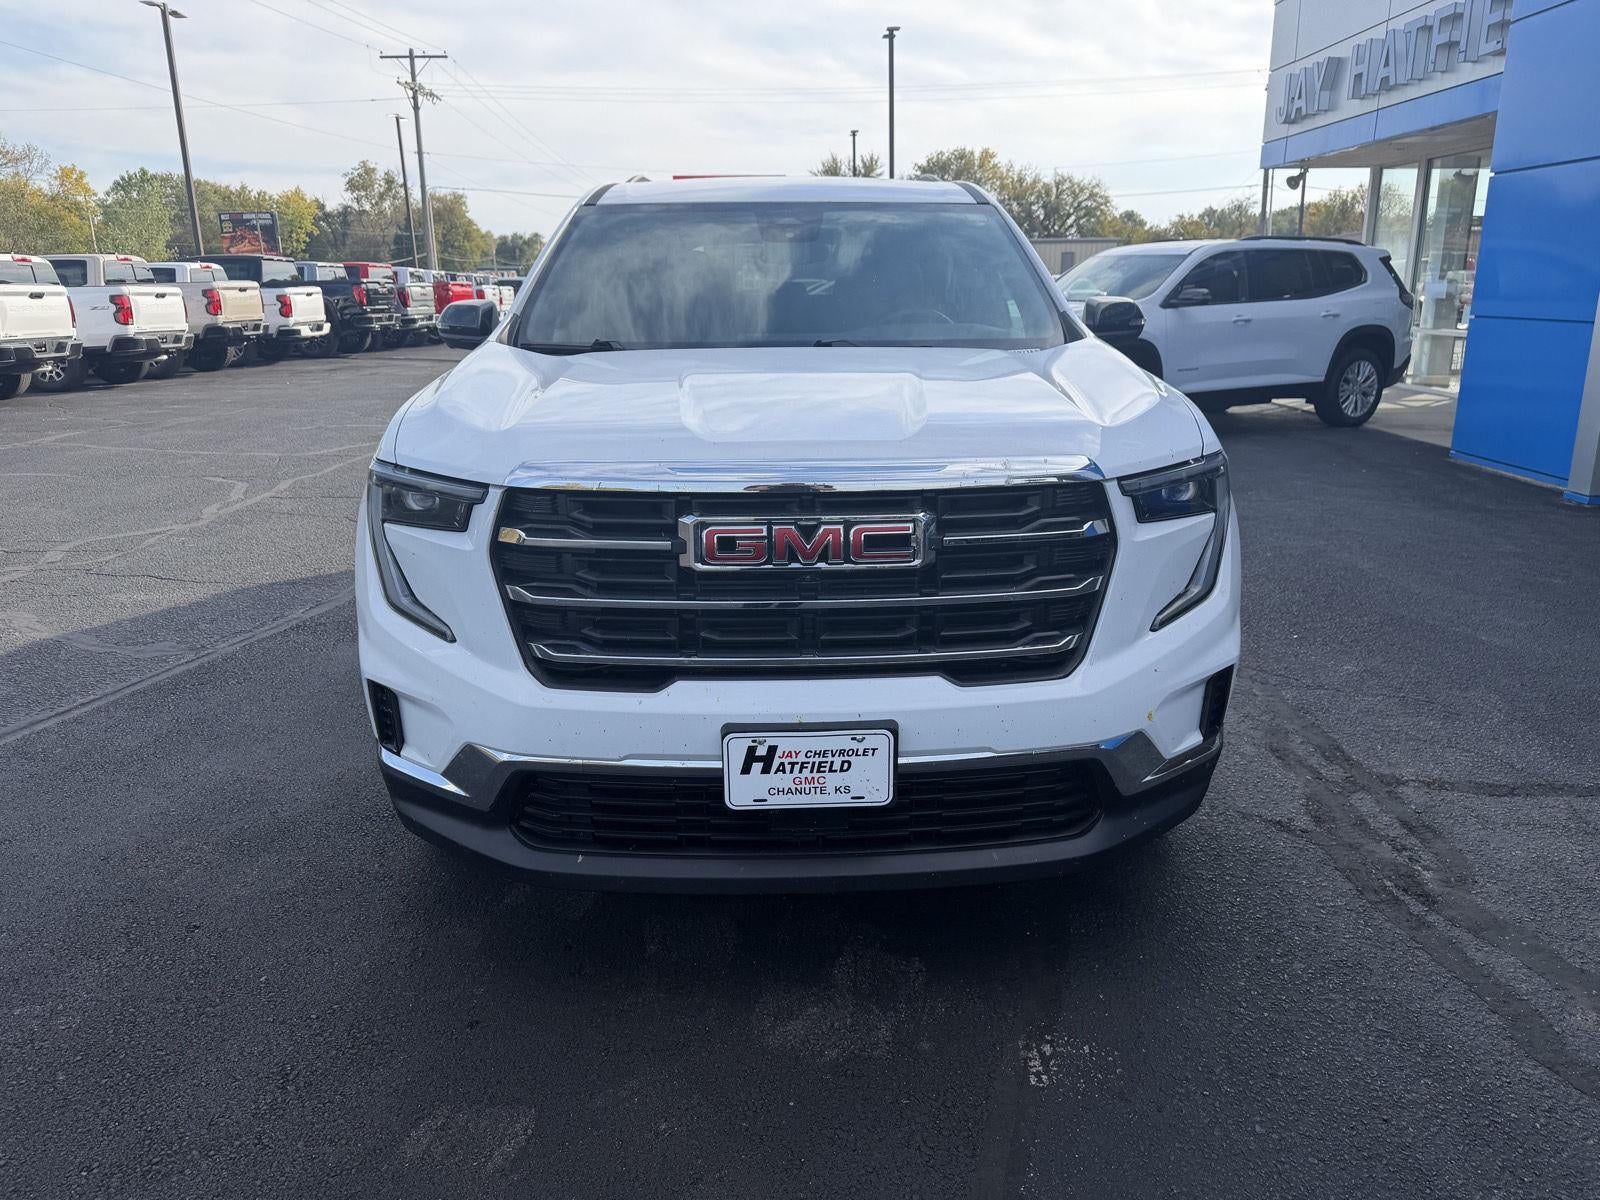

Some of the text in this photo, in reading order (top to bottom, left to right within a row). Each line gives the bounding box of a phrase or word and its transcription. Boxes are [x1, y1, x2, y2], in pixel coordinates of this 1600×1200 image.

[1276, 56, 1339, 124] JAY
[703, 523, 914, 565] GMC
[740, 745, 852, 775] HATFIELD
[778, 747, 879, 759] JAY CHEVROLET
[768, 785, 851, 796] CHANUTE, KS
[792, 775, 827, 786] GMC
